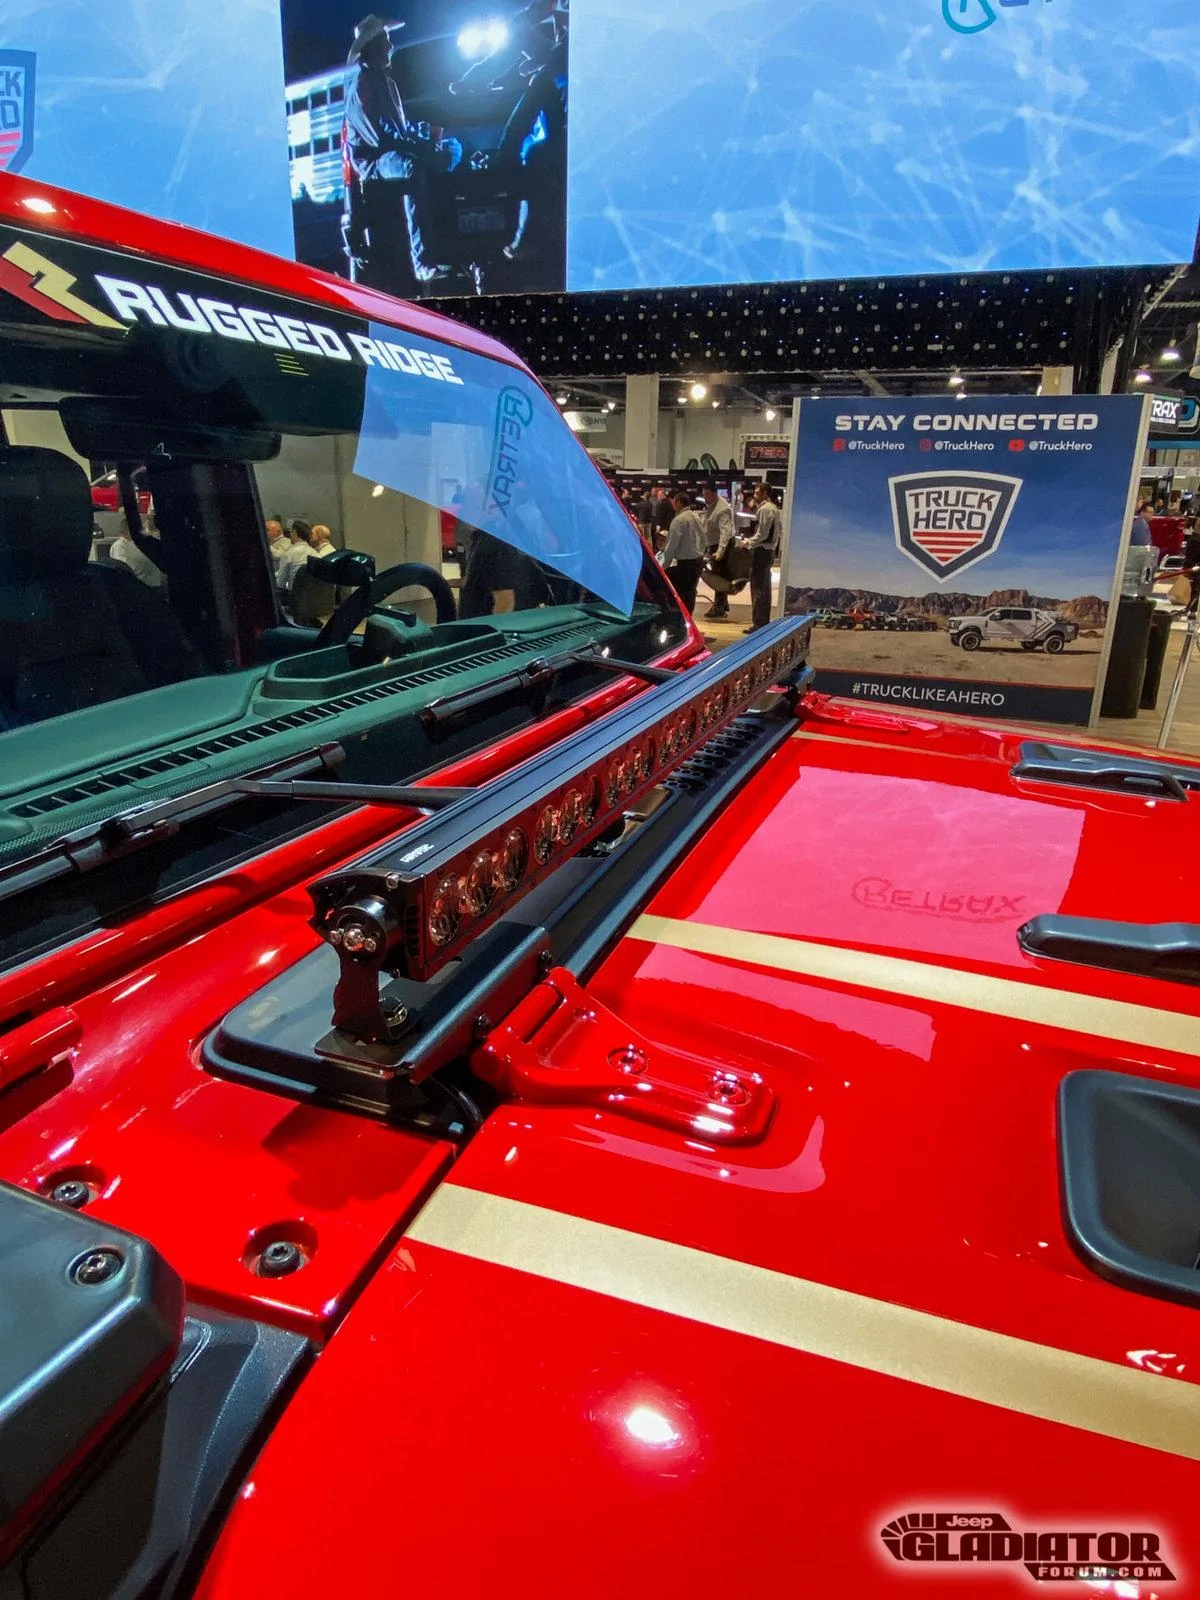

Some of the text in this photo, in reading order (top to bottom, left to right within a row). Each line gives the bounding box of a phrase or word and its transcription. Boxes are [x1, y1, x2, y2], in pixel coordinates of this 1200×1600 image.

[94, 273, 465, 385] RUGGED RIDGE
[834, 413, 1099, 432] STAY CONNECTED
[848, 439, 905, 451] @TruckHero
[934, 440, 995, 452] @TruckHero
[1028, 440, 1093, 452] @TruckHero
[908, 490, 997, 512] TRUCK
[913, 509, 987, 531] HERO
[852, 682, 1005, 706] #TRUCKLIKEAHERO
